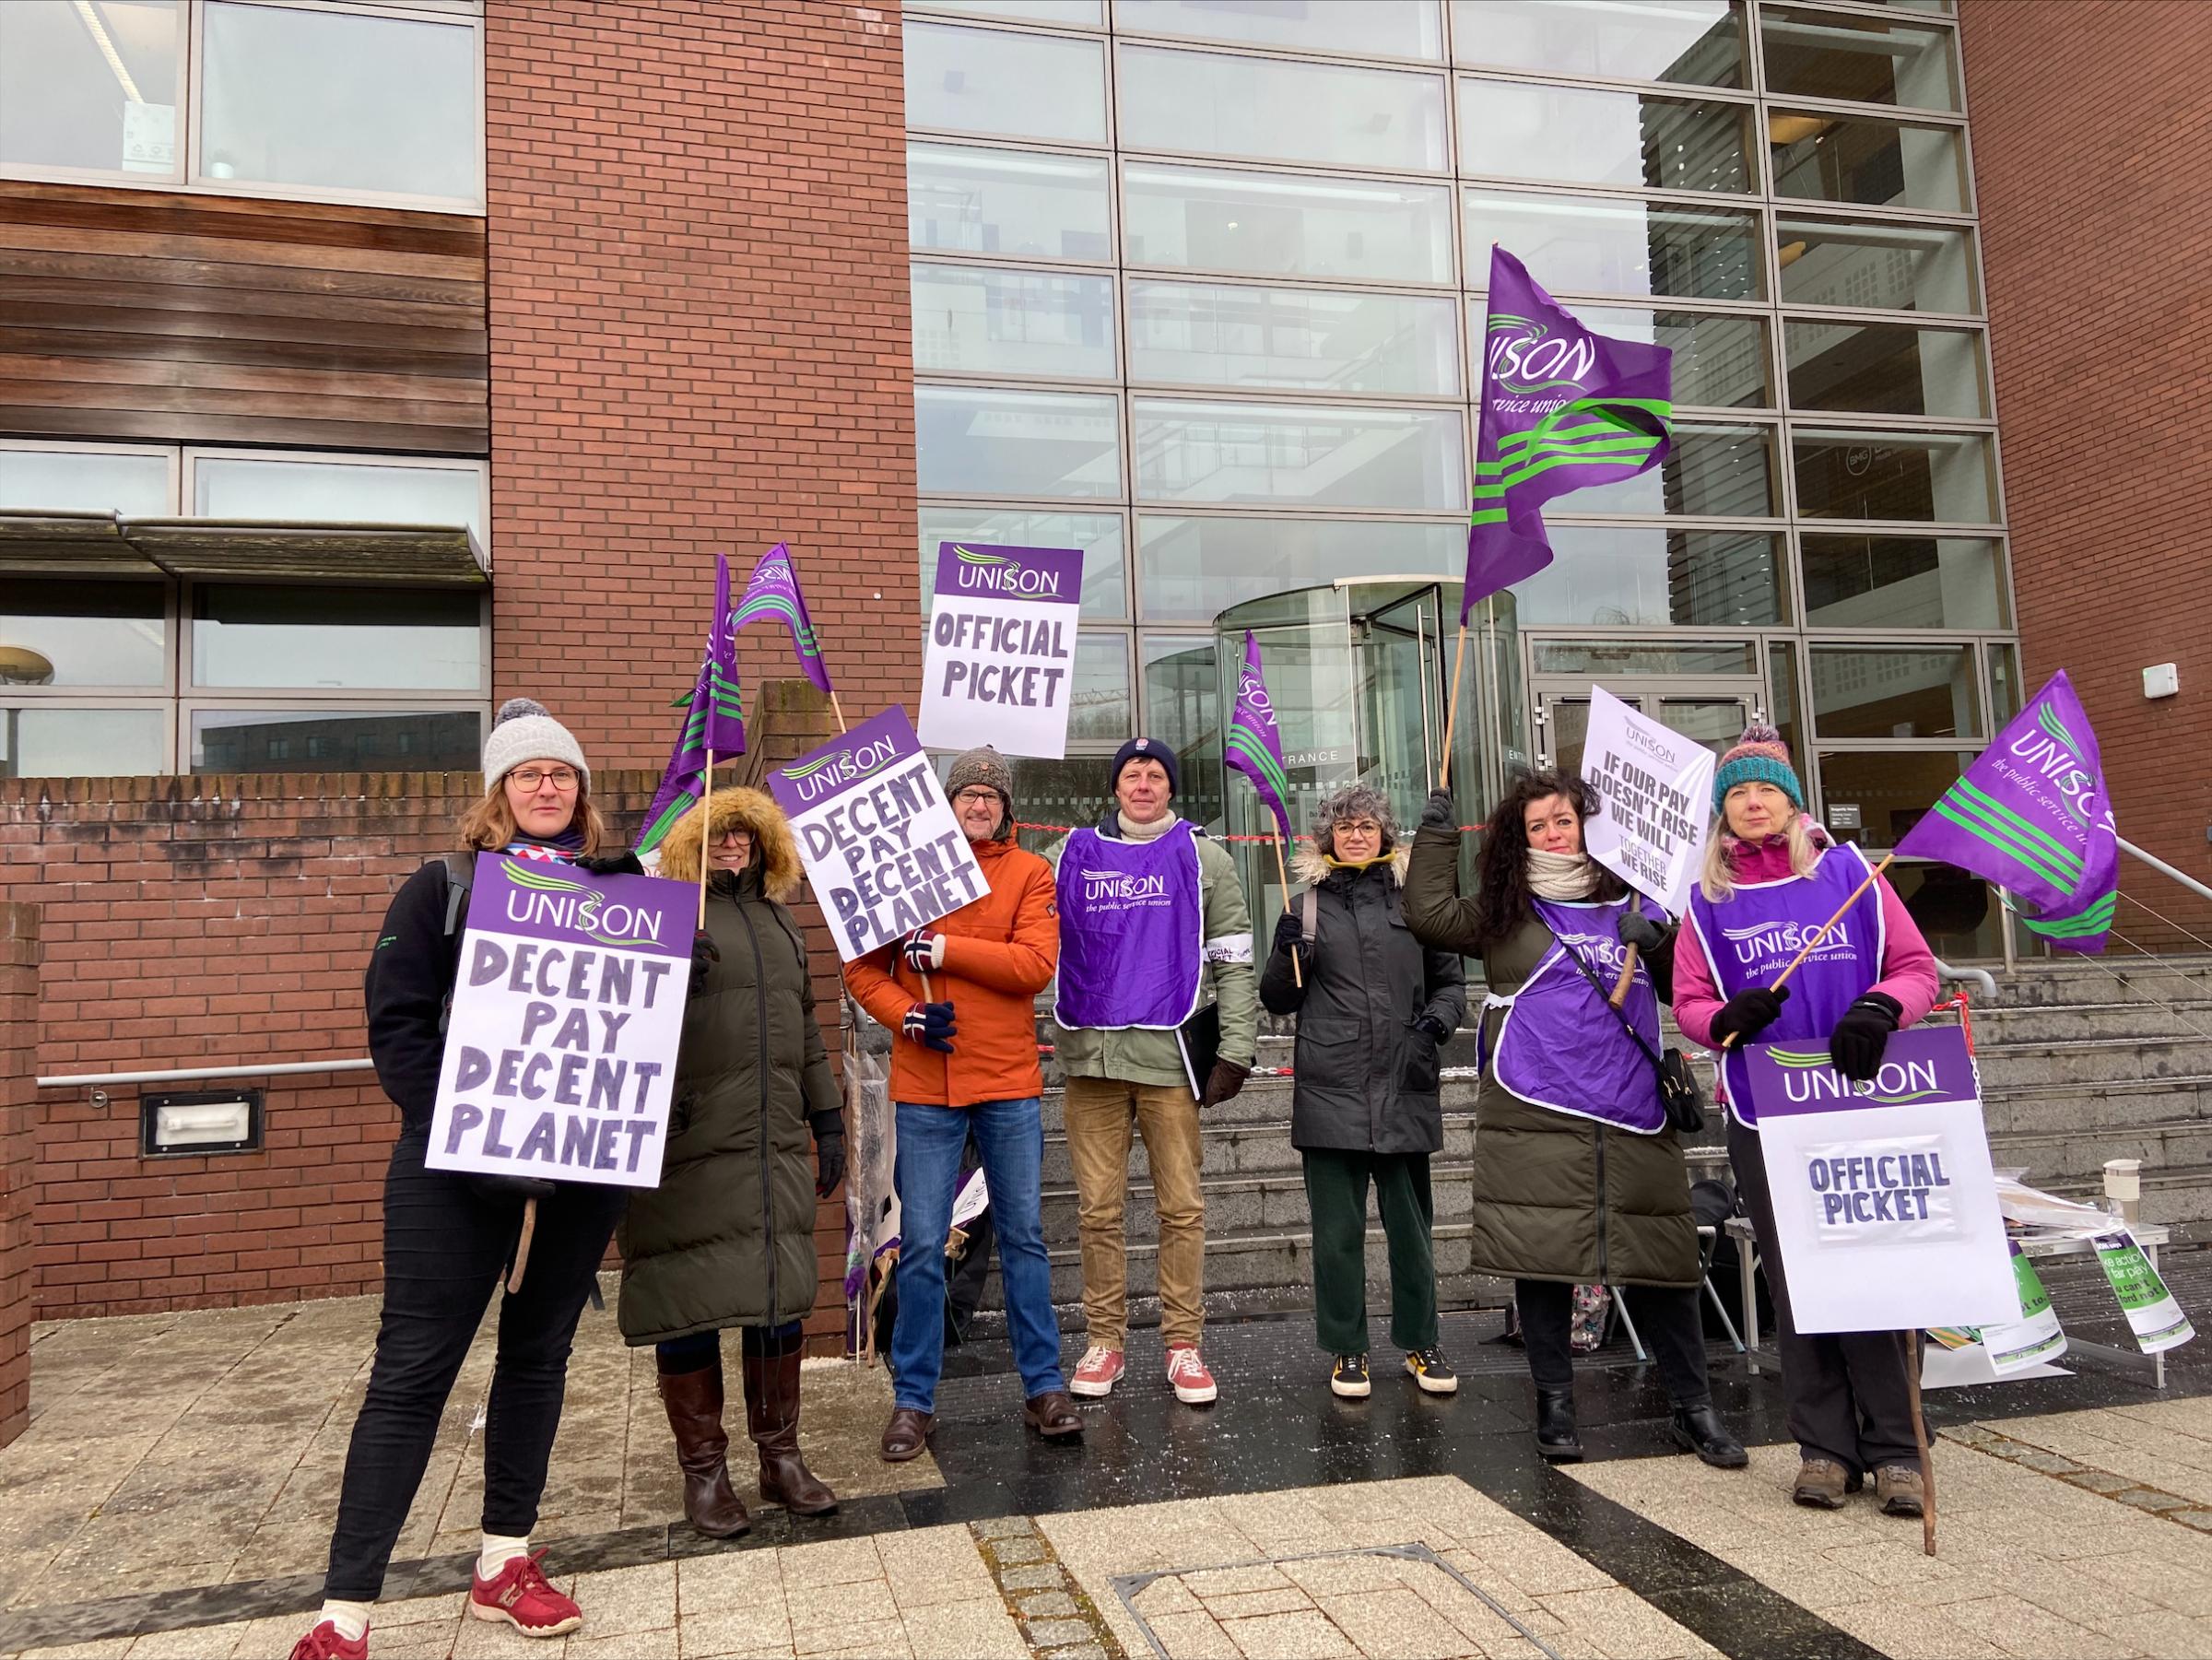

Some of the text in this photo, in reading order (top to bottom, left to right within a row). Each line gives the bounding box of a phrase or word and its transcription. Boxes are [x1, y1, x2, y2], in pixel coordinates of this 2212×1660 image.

[1492, 394, 1567, 414] rvice unio
[958, 566, 1059, 593] UNISON
[934, 612, 1068, 658] OFFICIAL
[942, 660, 1065, 707] PICKET
[796, 735, 896, 802] UNISON
[1626, 726, 1676, 763] UNISON
[1590, 766, 1699, 846] DOESN'T RISE
[1604, 750, 1620, 774] IF
[1622, 761, 1656, 798] OUR
[1659, 783, 1690, 816] PAY
[1992, 759, 2078, 831] the public service
[801, 762, 935, 863] DECENT
[1611, 801, 1674, 856] WE WILL
[842, 818, 912, 876] PAY
[1618, 834, 1666, 875] TOGETHER
[1620, 849, 1667, 892] WE RISE
[829, 830, 961, 923] DECENT
[1086, 876, 1163, 900] UNISON
[506, 889, 662, 941] UNISON
[844, 860, 979, 956] PLANET
[1086, 904, 1096, 912] the
[1099, 901, 1122, 912] public
[1123, 900, 1147, 910] service
[1735, 923, 1849, 963] UNISON
[1746, 950, 1857, 979] the public rvice union
[469, 938, 671, 1008] DECENT
[520, 1001, 632, 1054] PAY
[454, 1045, 662, 1113] DECENT
[444, 1104, 657, 1172] PLANET
[1808, 1153, 1950, 1192] OFFICIAL
[1823, 1188, 1930, 1224] PICKET
[2140, 1288, 2159, 1301] not
